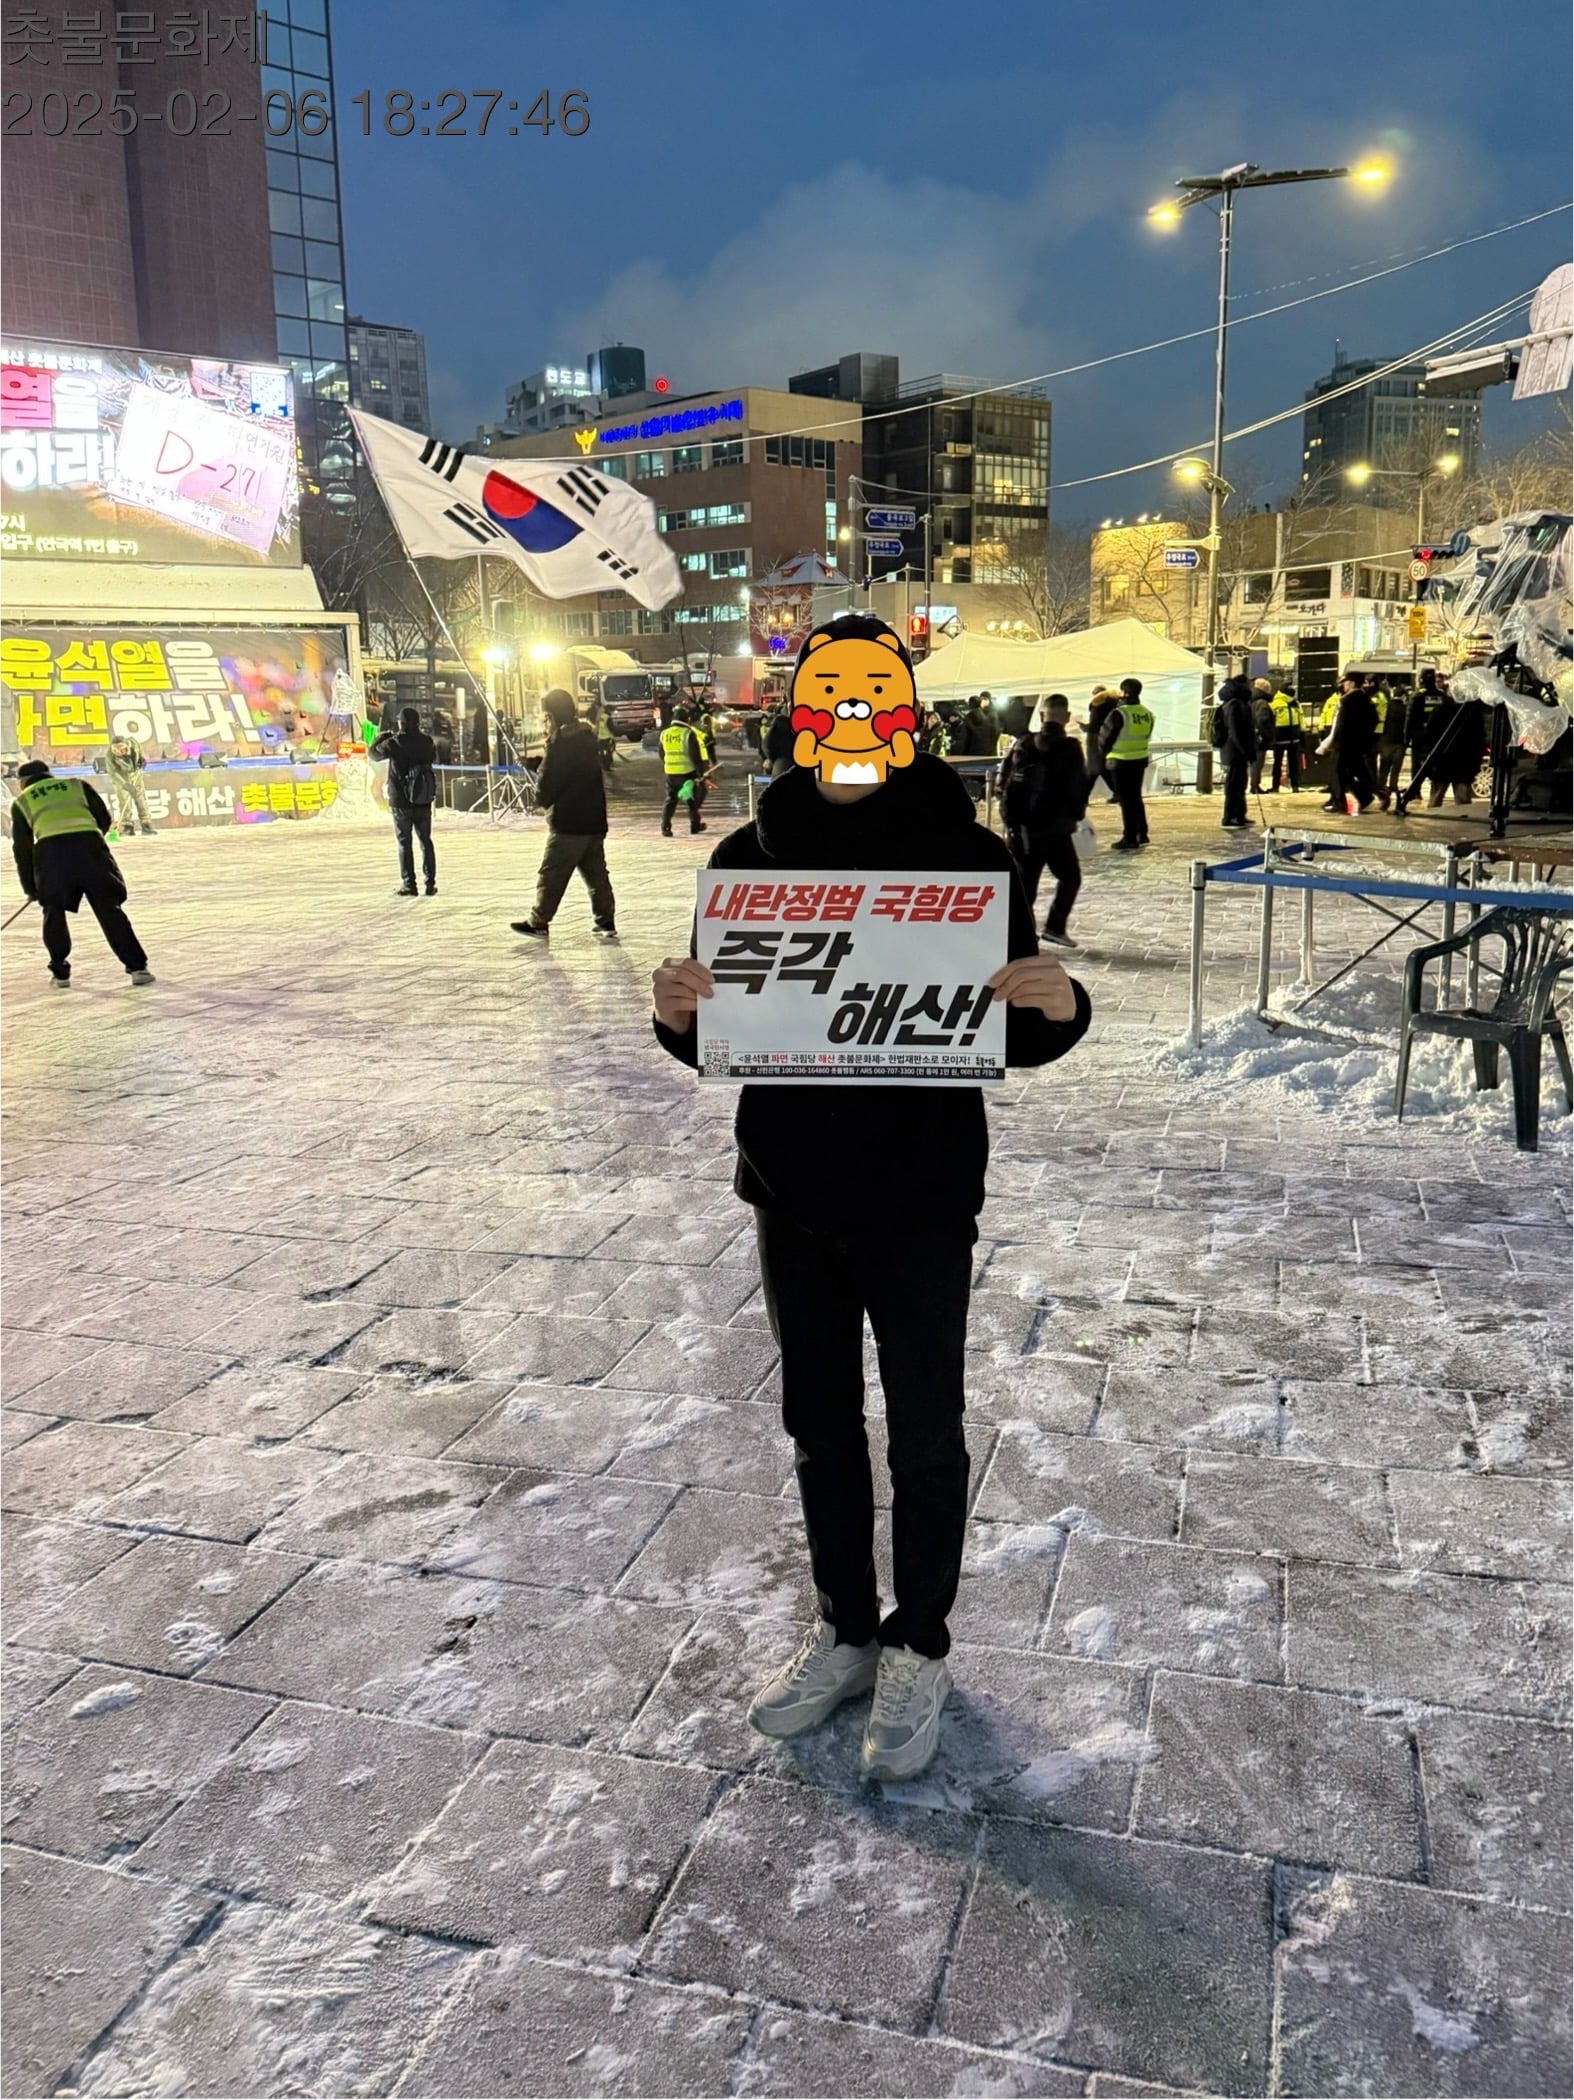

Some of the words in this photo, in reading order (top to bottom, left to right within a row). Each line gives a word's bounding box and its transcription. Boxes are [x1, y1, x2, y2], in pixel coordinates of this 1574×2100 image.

[155, 429, 257, 497] D-27
[1413, 566, 1425, 577] 50
[1, 638, 229, 691] 윤석열을
[176, 784, 236, 819] 해산
[703, 883, 867, 922] 내란정범
[870, 884, 996, 923] 국힘당
[710, 930, 854, 995] 즉각
[827, 982, 996, 1047] 해산!
[738, 1054, 769, 1064] <윤석열
[771, 1054, 788, 1064] 파면
[791, 1054, 816, 1064] 국힘당
[818, 1054, 835, 1064] 해산
[837, 1054, 886, 1065] 촛불문화제>
[888, 1055, 939, 1065] 헌법재판소로
[941, 1055, 971, 1065] 모이자!
